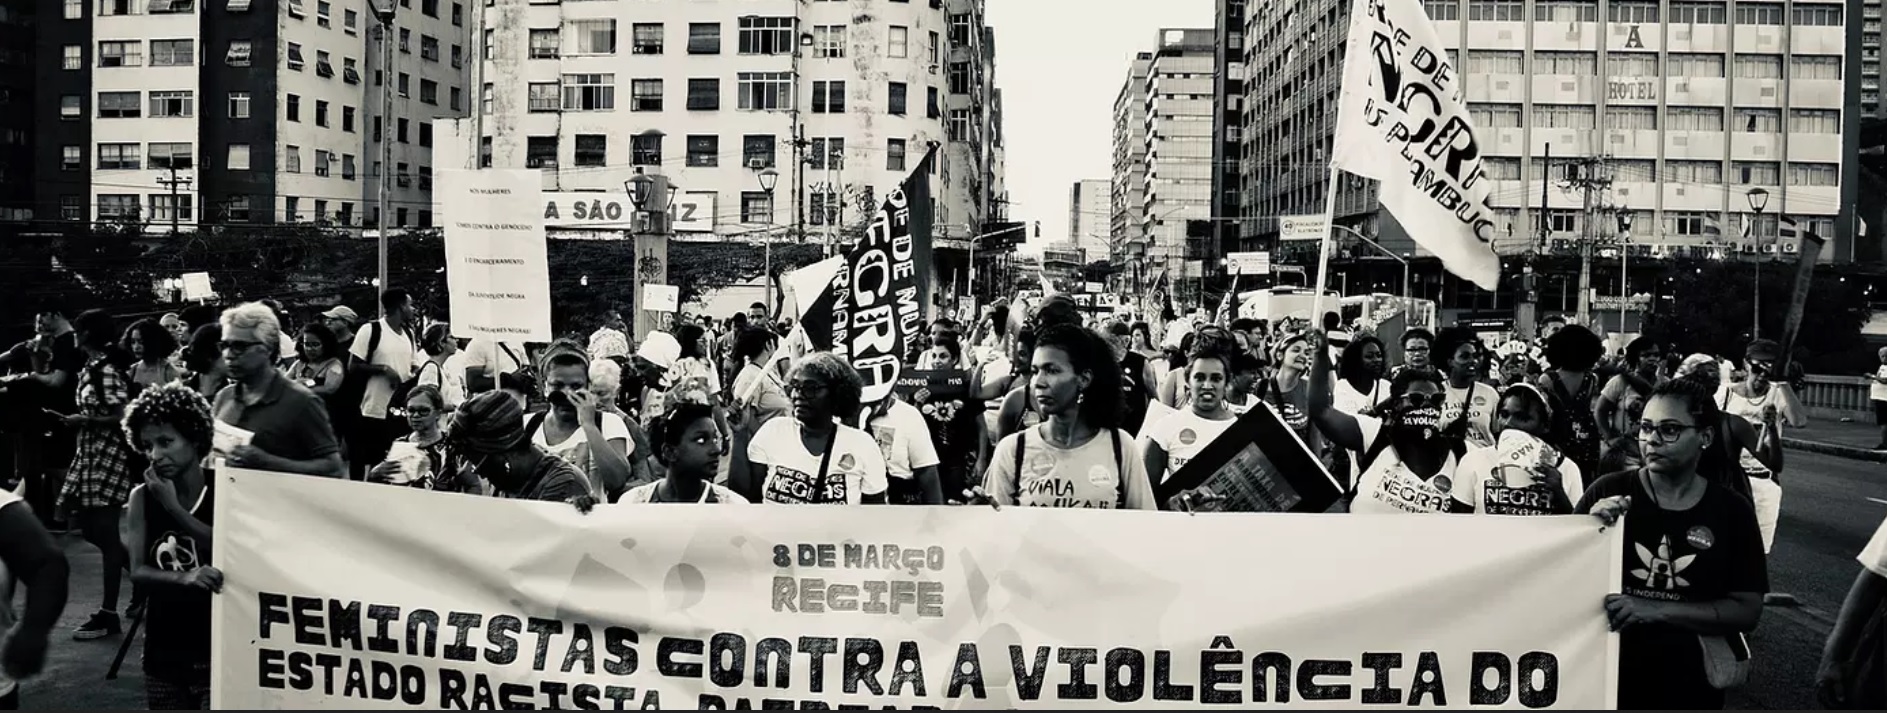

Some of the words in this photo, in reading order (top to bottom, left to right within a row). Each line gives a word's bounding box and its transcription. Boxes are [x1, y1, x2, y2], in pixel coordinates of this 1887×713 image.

[1625, 25, 1644, 48] A
[1607, 82, 1656, 100] HOTEL
[573, 199, 622, 220] SÃO
[1382, 479, 1452, 514] NEGRAS
[773, 544, 792, 568] 8
[797, 543, 836, 568] DE
[844, 543, 944, 577] MARÇO
[772, 576, 944, 617] RECIFE
[258, 591, 640, 676] FEMINISTAS
[656, 632, 928, 697] CONTRA
[946, 642, 988, 699] A
[1008, 635, 1448, 706] VIOLÊNCIA
[1469, 650, 1558, 708] DO
[258, 648, 426, 706] ESTADO
